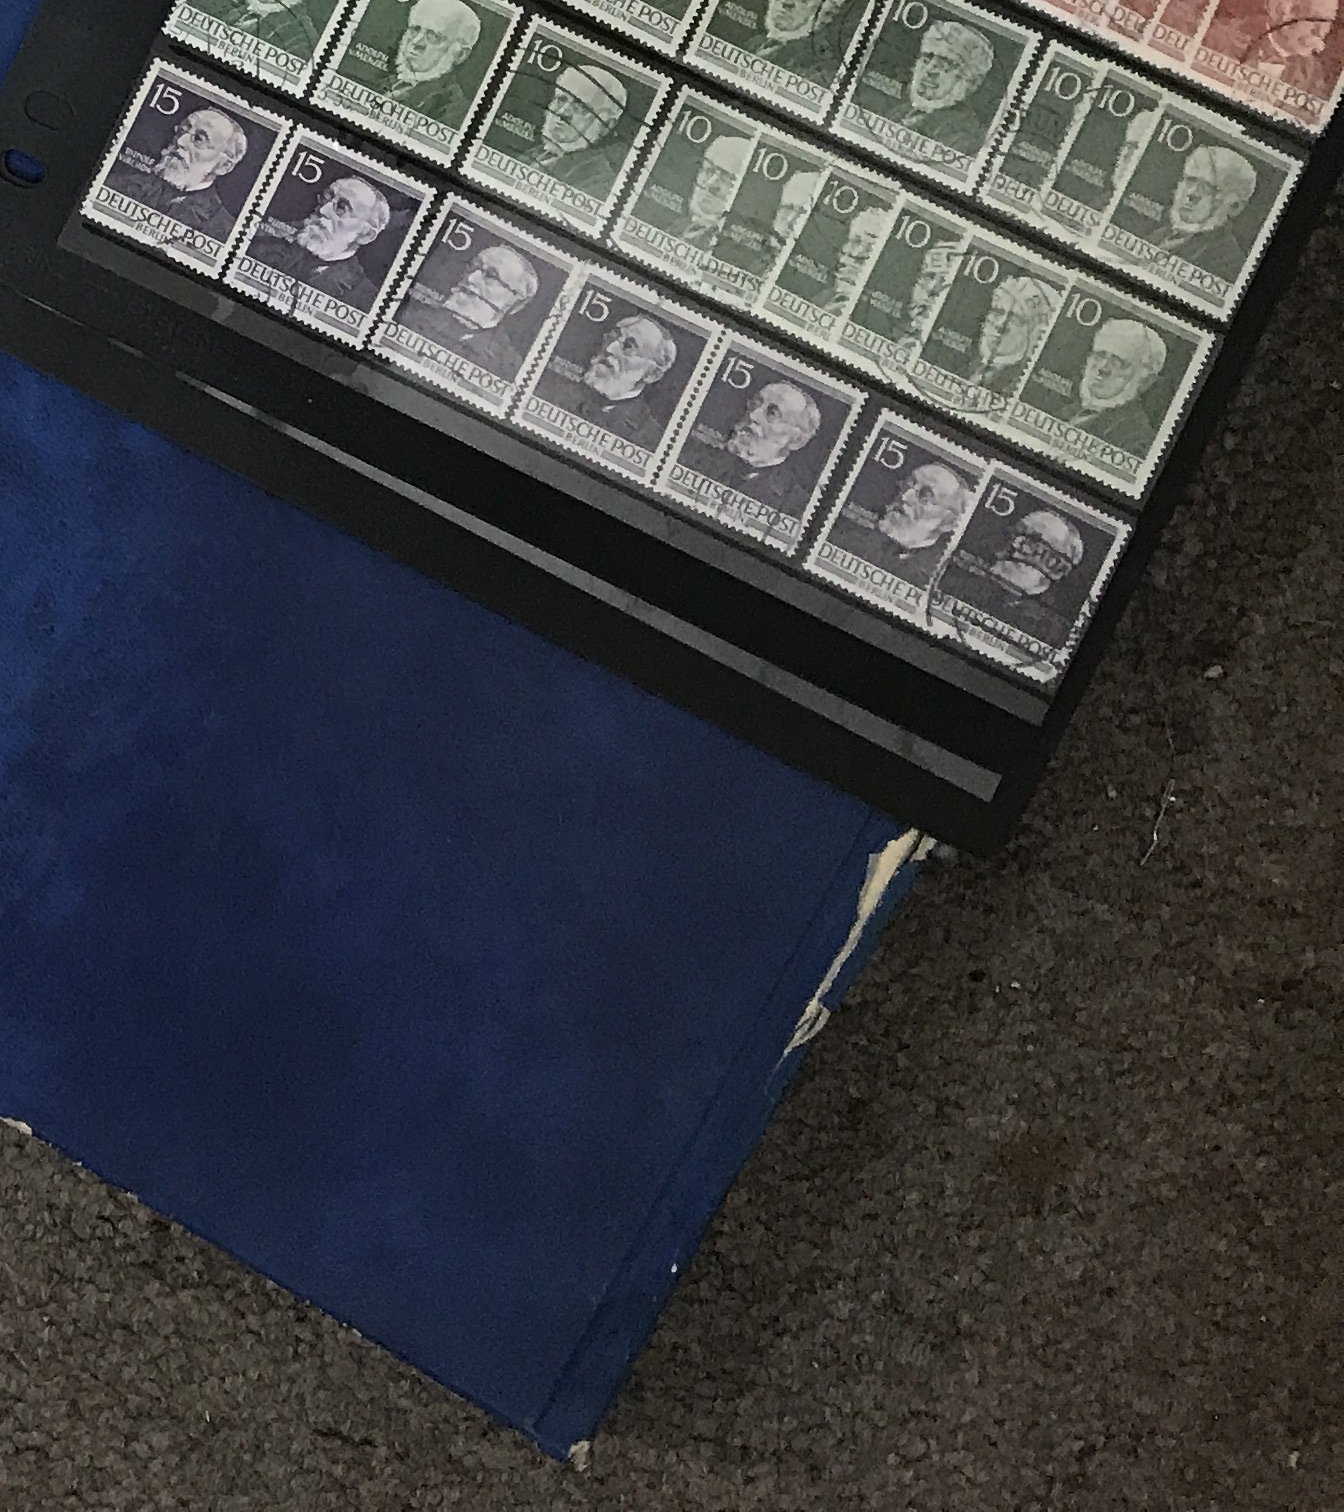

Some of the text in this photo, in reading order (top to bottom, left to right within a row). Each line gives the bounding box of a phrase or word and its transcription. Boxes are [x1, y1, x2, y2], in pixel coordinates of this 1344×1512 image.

[637, 5, 681, 36] POST
[177, 6, 309, 75] DEUTSCHE POST
[526, 40, 562, 72] 10
[699, 36, 784, 87] DEUTSCHE
[149, 82, 182, 115] 15
[1044, 67, 1082, 100] 10
[1099, 85, 1134, 117] 10
[413, 112, 459, 144] POST
[677, 111, 712, 144] 10
[1159, 119, 1193, 152] 10
[291, 151, 325, 184] 15
[474, 143, 606, 217] DEUTSCHE POST
[753, 148, 788, 181] 10
[822, 181, 859, 214] 10
[94, 187, 225, 259] DEUTSCHE POST
[441, 218, 474, 251] 15
[895, 215, 931, 248] 10
[964, 252, 999, 285] 10
[237, 255, 367, 329] DEUTSCHE POST
[578, 289, 612, 322] 15
[1065, 293, 1102, 327] 10
[382, 321, 510, 397] DEUTSCHE POST
[721, 356, 754, 389] 15
[525, 396, 654, 469] DEUTSCHE POST
[1012, 402, 1099, 457] DEUTSCHE
[874, 437, 908, 469] 15
[669, 465, 756, 516] DEUTSCHE
[984, 482, 1018, 517] 15
